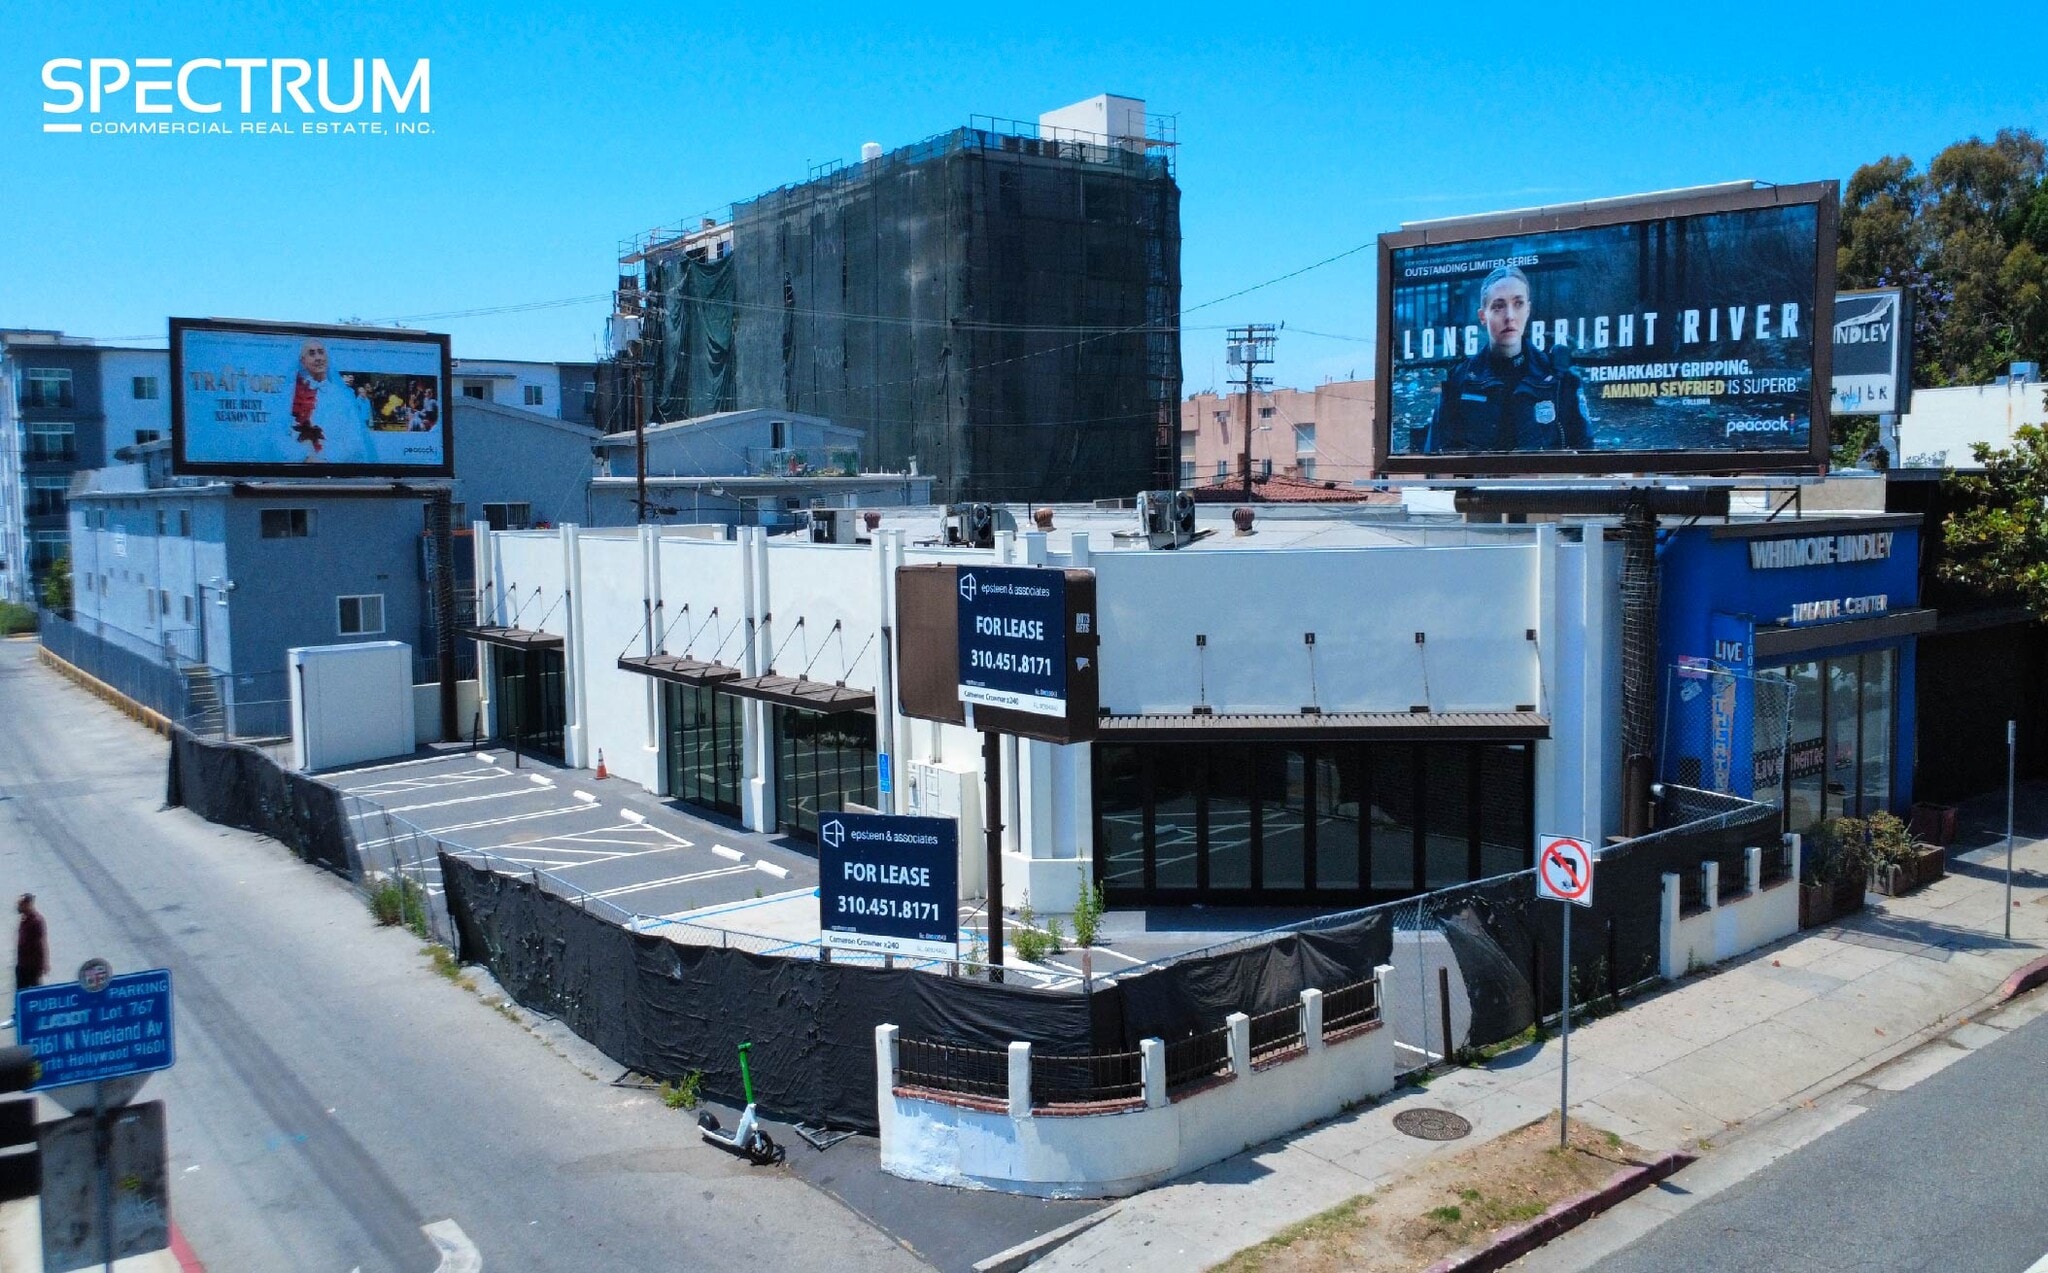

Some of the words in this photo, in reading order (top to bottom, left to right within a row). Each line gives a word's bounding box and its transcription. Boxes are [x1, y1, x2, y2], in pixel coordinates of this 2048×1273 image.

[1405, 262, 1468, 277] OUTSTANDING
[1469, 258, 1506, 271] LIMITED
[1507, 255, 1539, 268] SERIES
[1404, 325, 1479, 360] LONG
[1531, 312, 1657, 352] BRIGHT
[1684, 302, 1799, 344] RIVER
[1585, 362, 1679, 383] "REMARKABLY
[1681, 359, 1753, 378] GRIPPING.
[1601, 382, 1658, 400] AMANDA
[1659, 380, 1725, 397] SEYFRIED
[1727, 380, 1741, 395] IS
[217, 399, 238, 411] THE
[1726, 416, 1789, 438] peacock
[403, 445, 434, 456] peacock
[1750, 532, 1893, 569] WHITMORE-LINDLEY
[981, 583, 1008, 594] epsteen
[1008, 583, 1014, 594] &
[1014, 584, 1050, 597] associates
[1792, 599, 1841, 623] THEATRE
[1845, 594, 1888, 614] CENTER
[976, 615, 1002, 636] FOR
[1004, 617, 1044, 641] LEASE
[971, 649, 1051, 676] 310.451.8171
[1715, 639, 1744, 662] LIVE
[851, 829, 885, 841] epsteen
[885, 830, 893, 841] &
[893, 832, 938, 845] associates
[844, 861, 876, 882] FOR
[880, 864, 930, 887] LEASE
[838, 895, 939, 921] 310.451.8171
[829, 935, 856, 946] Cameron
[883, 941, 900, 950] x240
[29, 994, 79, 1013] PUBLIC
[109, 980, 168, 999] PARKING
[100, 1004, 123, 1022] Lot
[128, 1000, 155, 1016] 767
[28, 1034, 58, 1056] 5161
[65, 1030, 75, 1049] N
[82, 1022, 141, 1048] Vineland
[147, 1020, 163, 1039] Av
[69, 1046, 129, 1068] Hollywood
[134, 1039, 166, 1056] 91601
